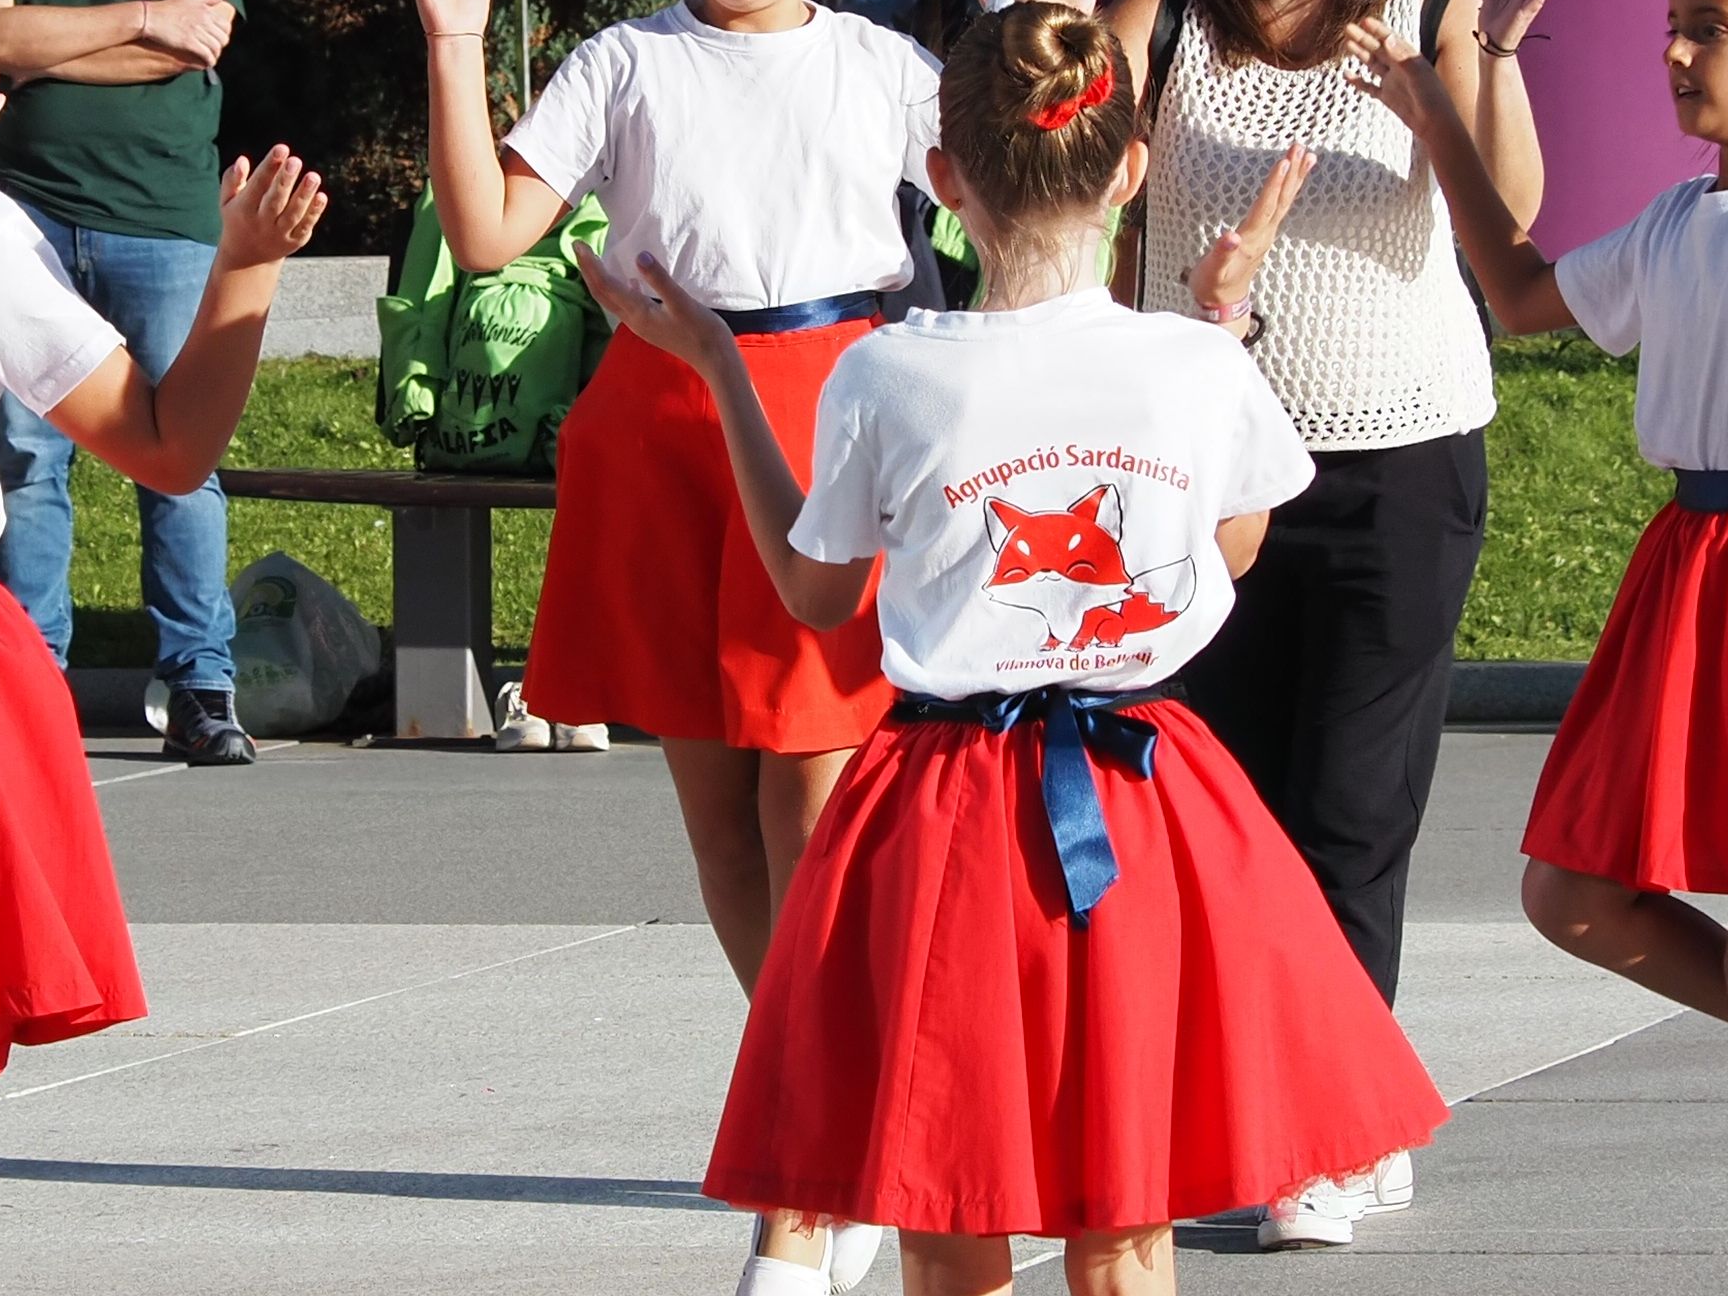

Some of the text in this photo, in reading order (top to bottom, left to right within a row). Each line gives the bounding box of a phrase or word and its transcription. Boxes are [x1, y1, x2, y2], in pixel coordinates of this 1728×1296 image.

[943, 444, 1191, 509] Agrupació Sardanista
[995, 656, 1064, 674] Vilanova
[1068, 654, 1090, 671] de
